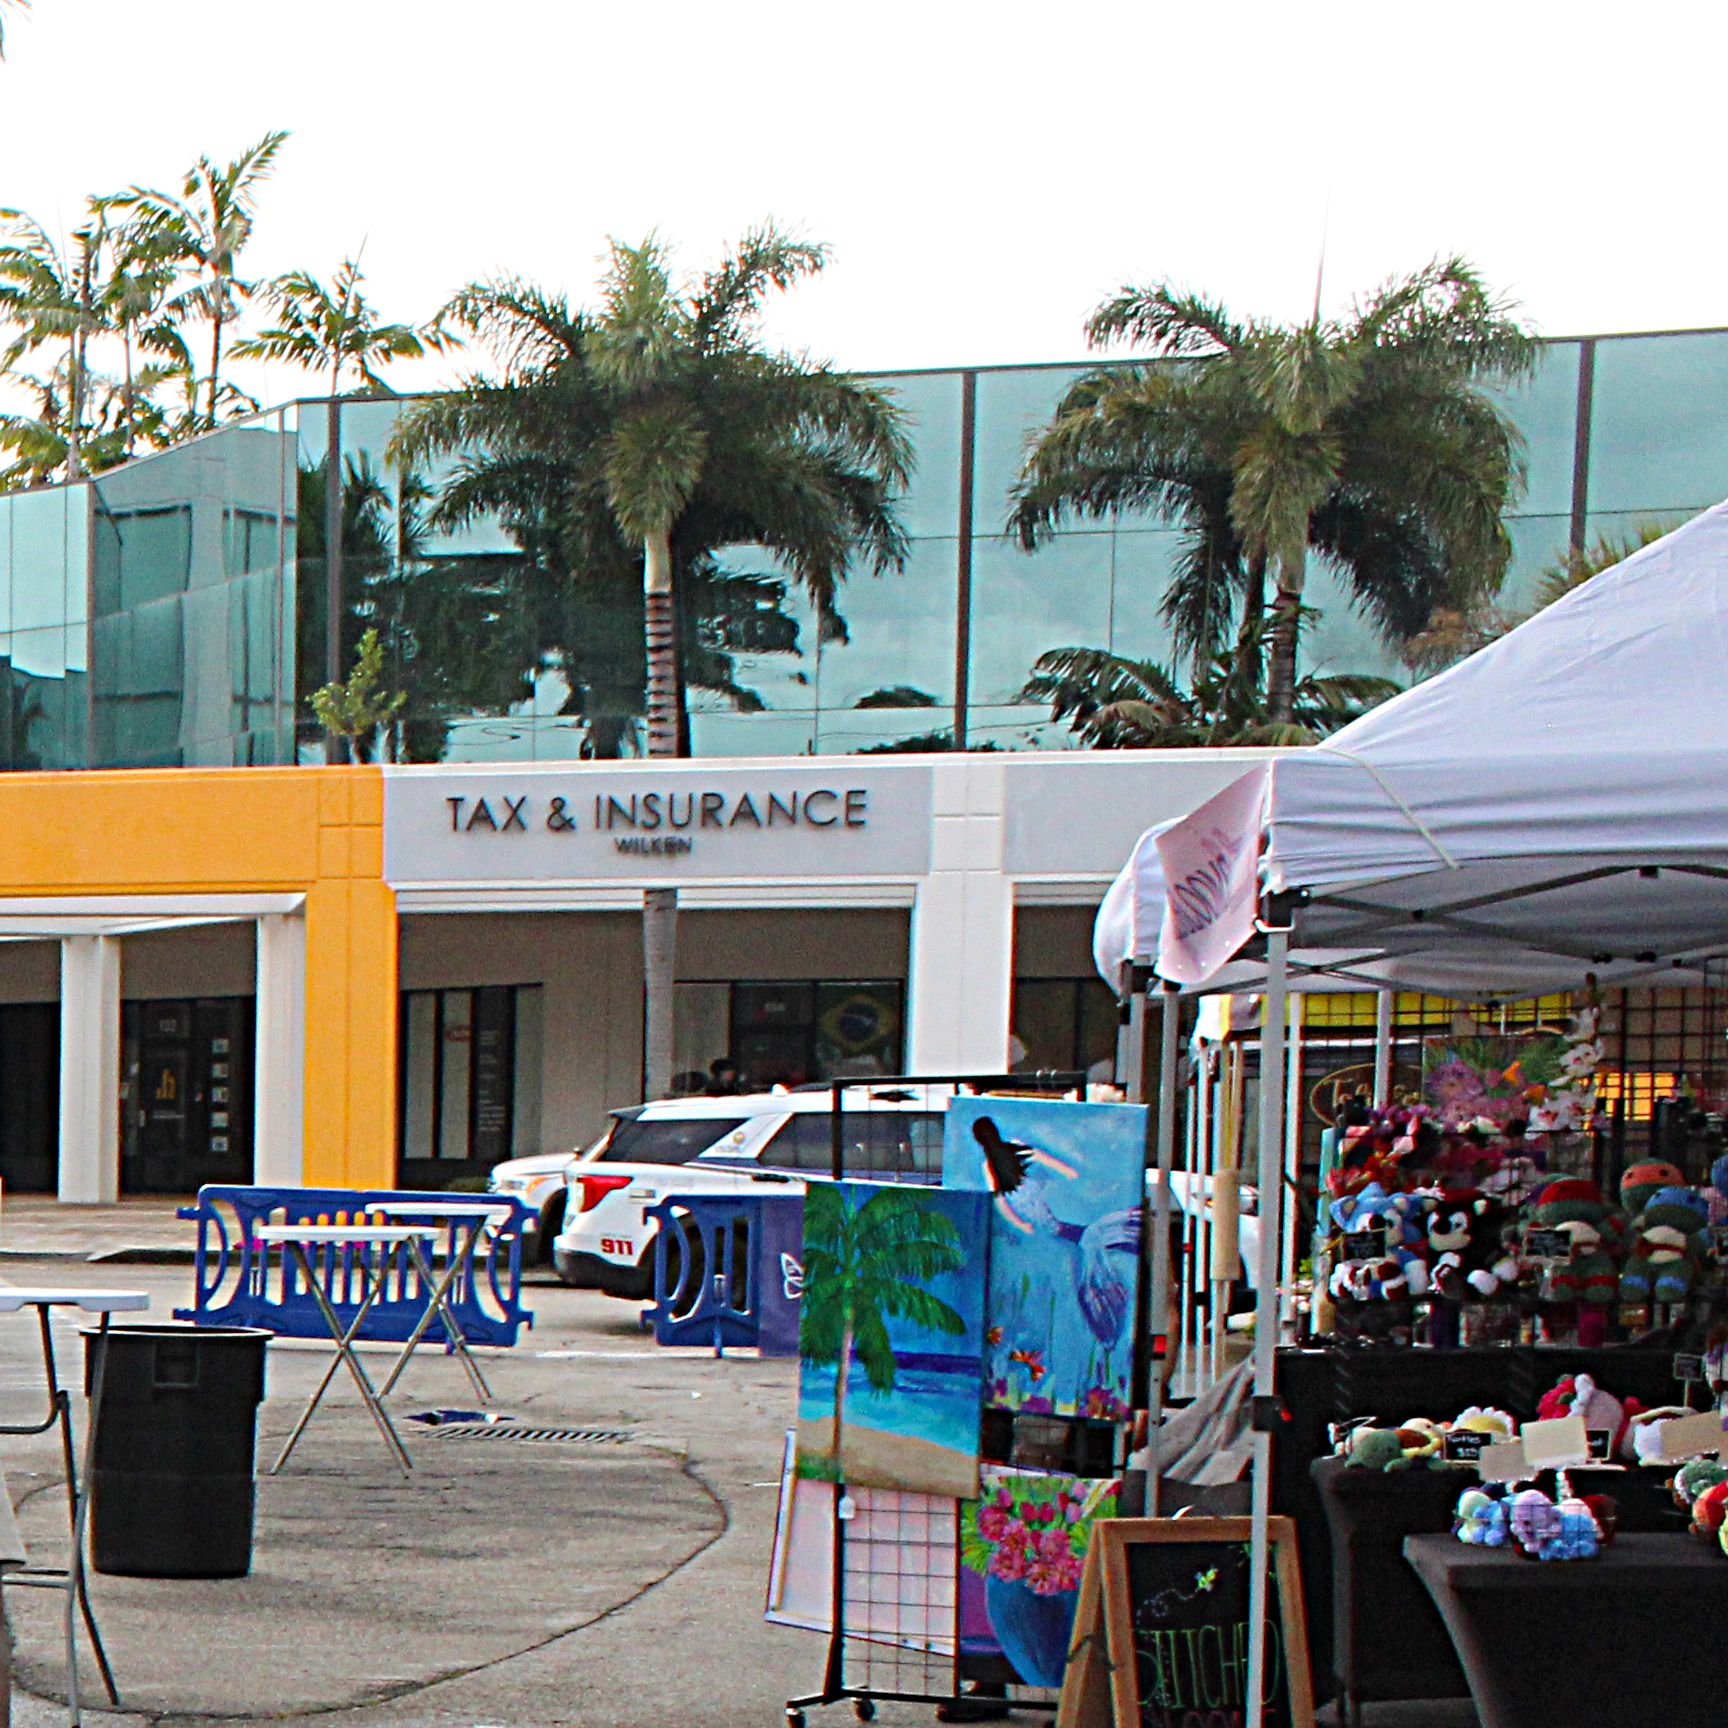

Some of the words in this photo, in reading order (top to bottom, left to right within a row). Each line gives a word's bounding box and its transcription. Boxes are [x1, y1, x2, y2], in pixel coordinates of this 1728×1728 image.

[446, 796, 528, 832] TAX
[546, 796, 577, 831] &
[594, 789, 869, 830] INSURANCE
[601, 1237, 633, 1256] 911
